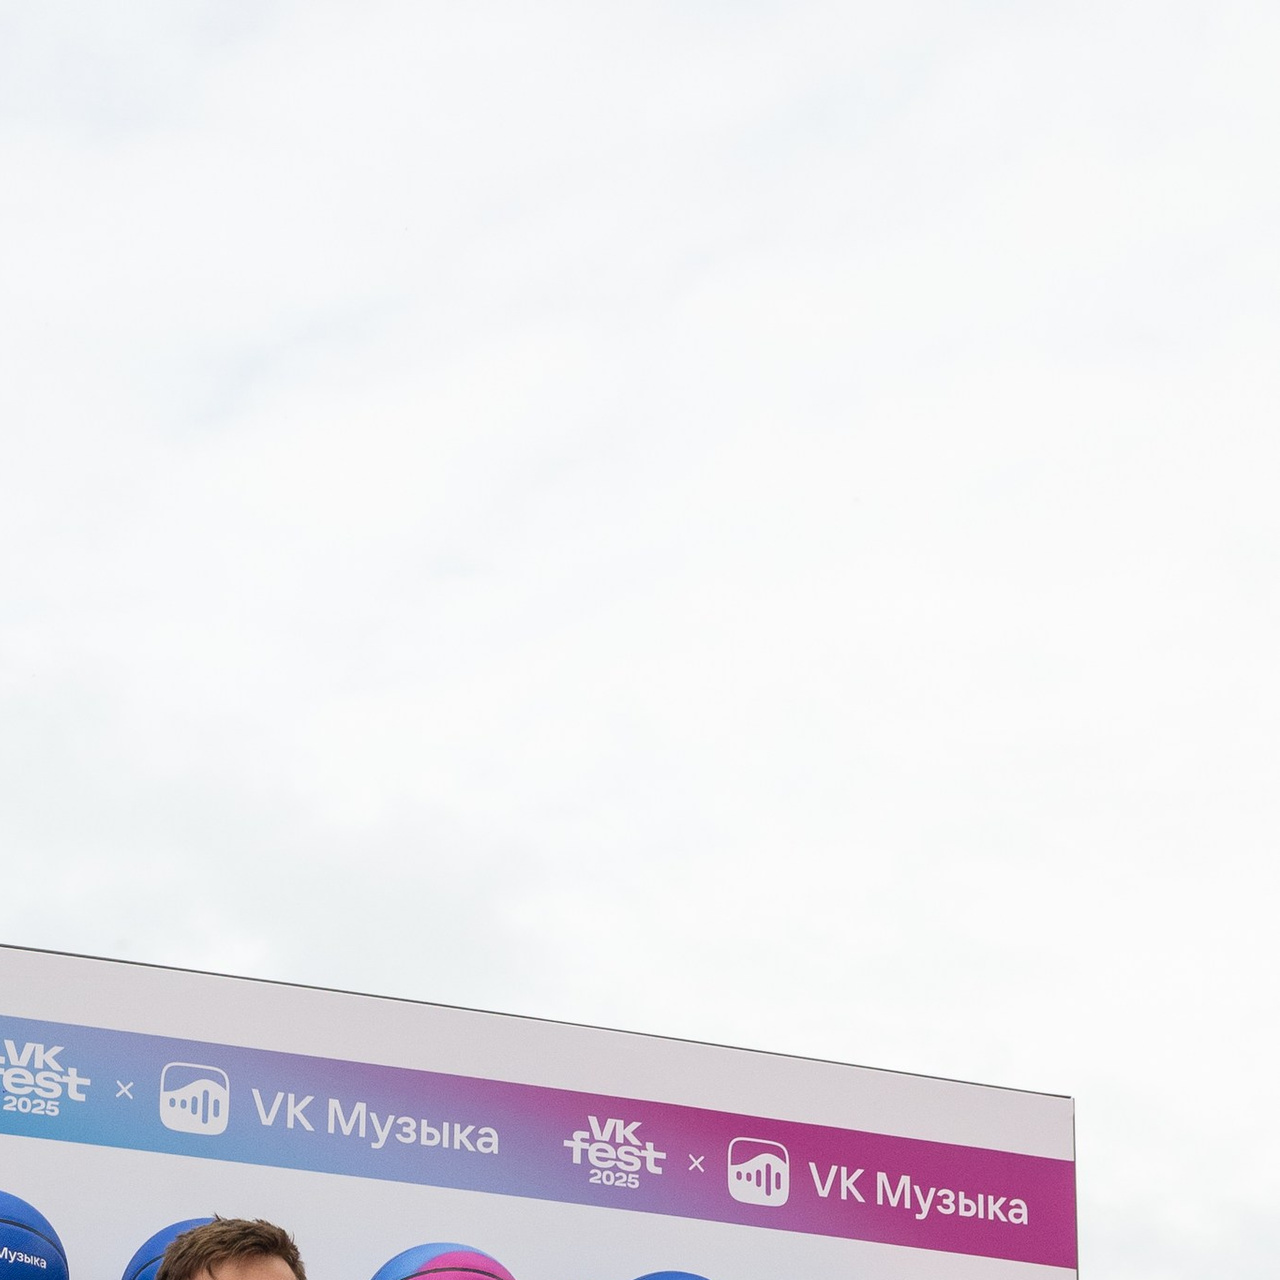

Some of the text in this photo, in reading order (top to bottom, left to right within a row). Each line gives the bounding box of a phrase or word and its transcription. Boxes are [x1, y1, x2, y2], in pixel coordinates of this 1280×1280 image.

[3, 1039, 65, 1071] VK
[2, 1095, 60, 1117] 2025
[251, 1088, 499, 1155] VK Музыка
[587, 1116, 643, 1146] VK
[563, 1130, 666, 1176] fest
[588, 1168, 640, 1190] 2025
[808, 1161, 1029, 1225] VK Музыка
